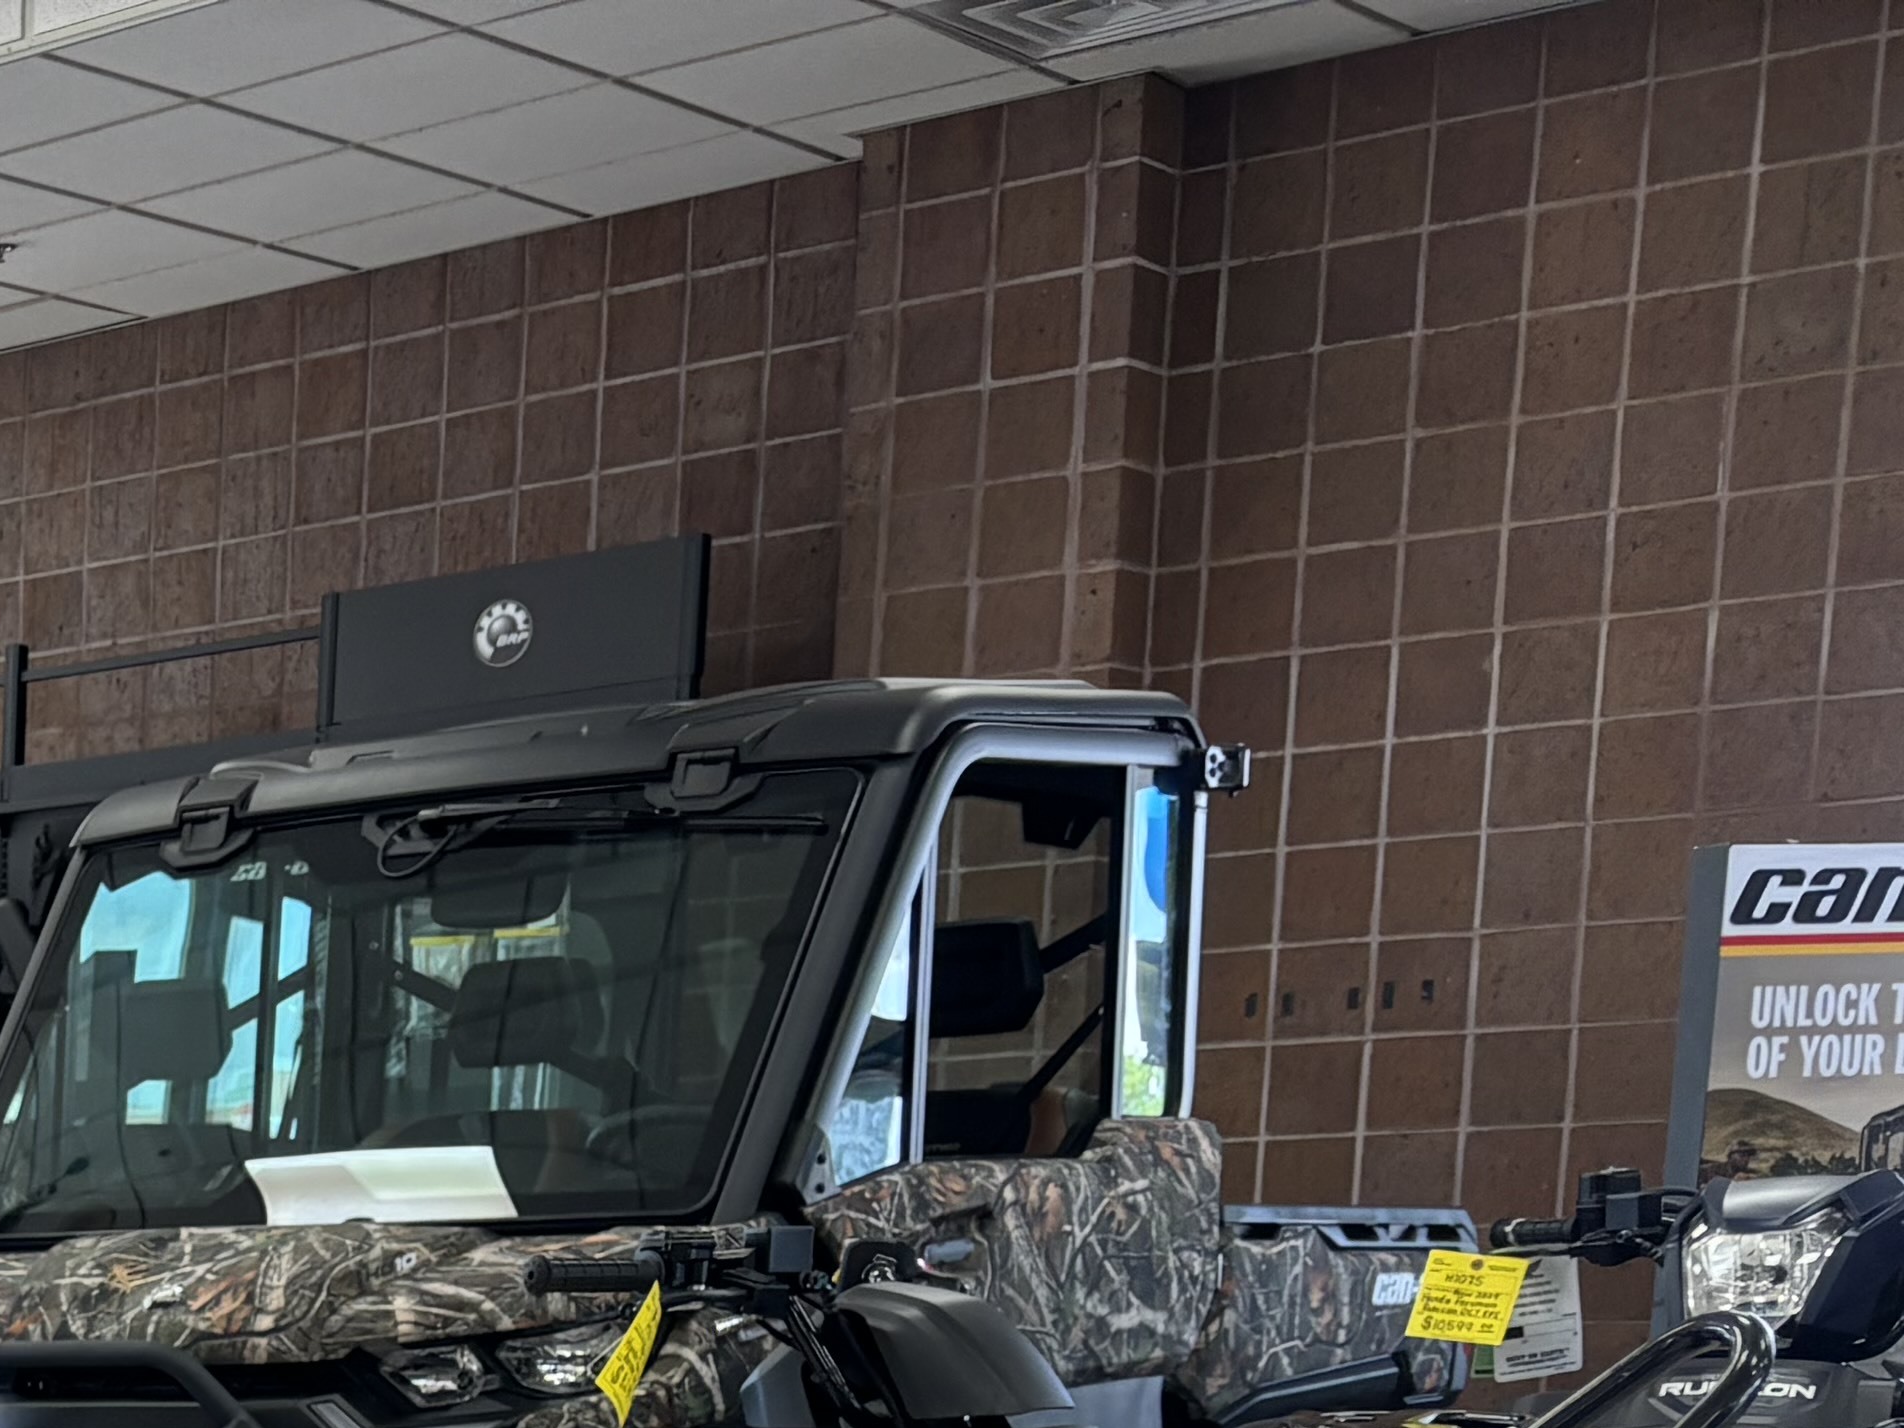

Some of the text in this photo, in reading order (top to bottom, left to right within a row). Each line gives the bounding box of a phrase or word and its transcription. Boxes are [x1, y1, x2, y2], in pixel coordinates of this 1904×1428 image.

[1750, 982, 1883, 1029] UNLOCK
[1746, 1034, 1791, 1080] OF
[1800, 1033, 1885, 1079] YOUR
